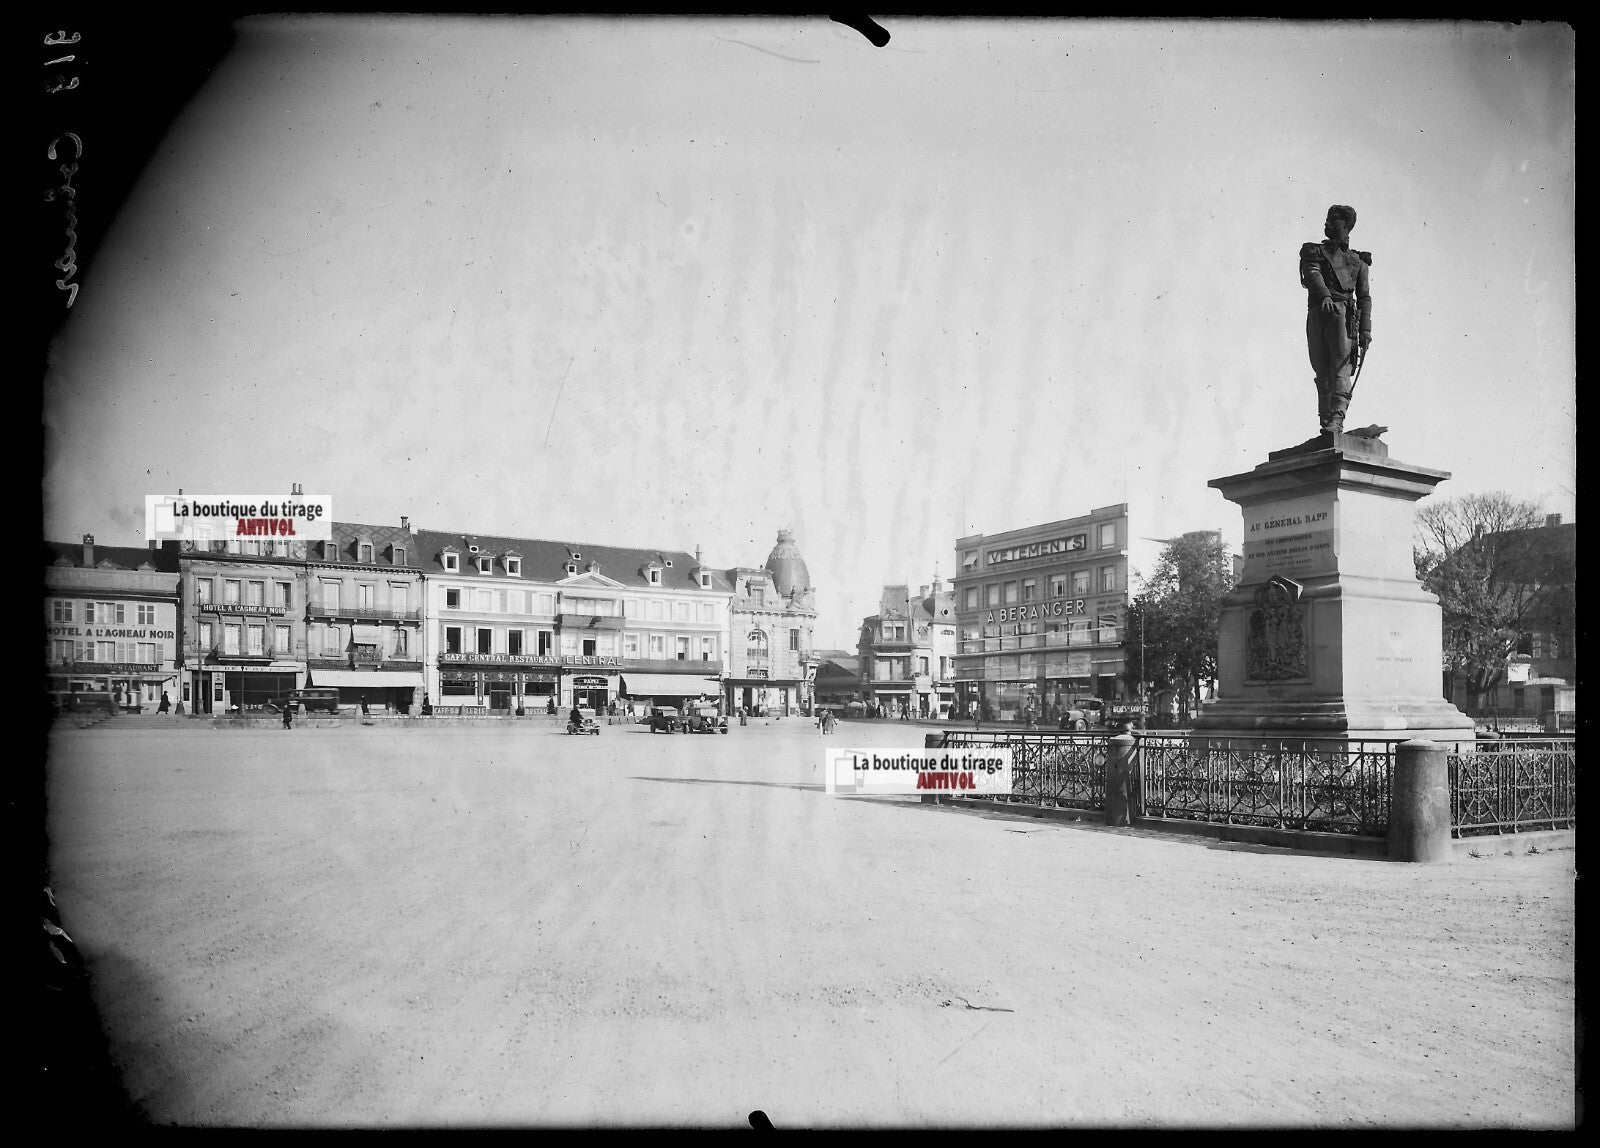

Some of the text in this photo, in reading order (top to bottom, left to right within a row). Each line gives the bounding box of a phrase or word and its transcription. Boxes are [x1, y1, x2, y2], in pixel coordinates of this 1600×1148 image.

[1250, 523, 1261, 532] AU
[1305, 512, 1328, 523] RAPP
[203, 603, 226, 612] HOTEL
[235, 605, 268, 613] L'AGNEAU
[988, 610, 996, 624] A
[1000, 600, 1084, 622] BERANGER
[86, 629, 93, 637] A
[96, 629, 146, 639] L'AGNEAU
[150, 630, 175, 639] NOIR
[469, 654, 507, 663] CENTRAL
[509, 655, 560, 664] RESTAURANT
[566, 655, 622, 666] CENTRAL
